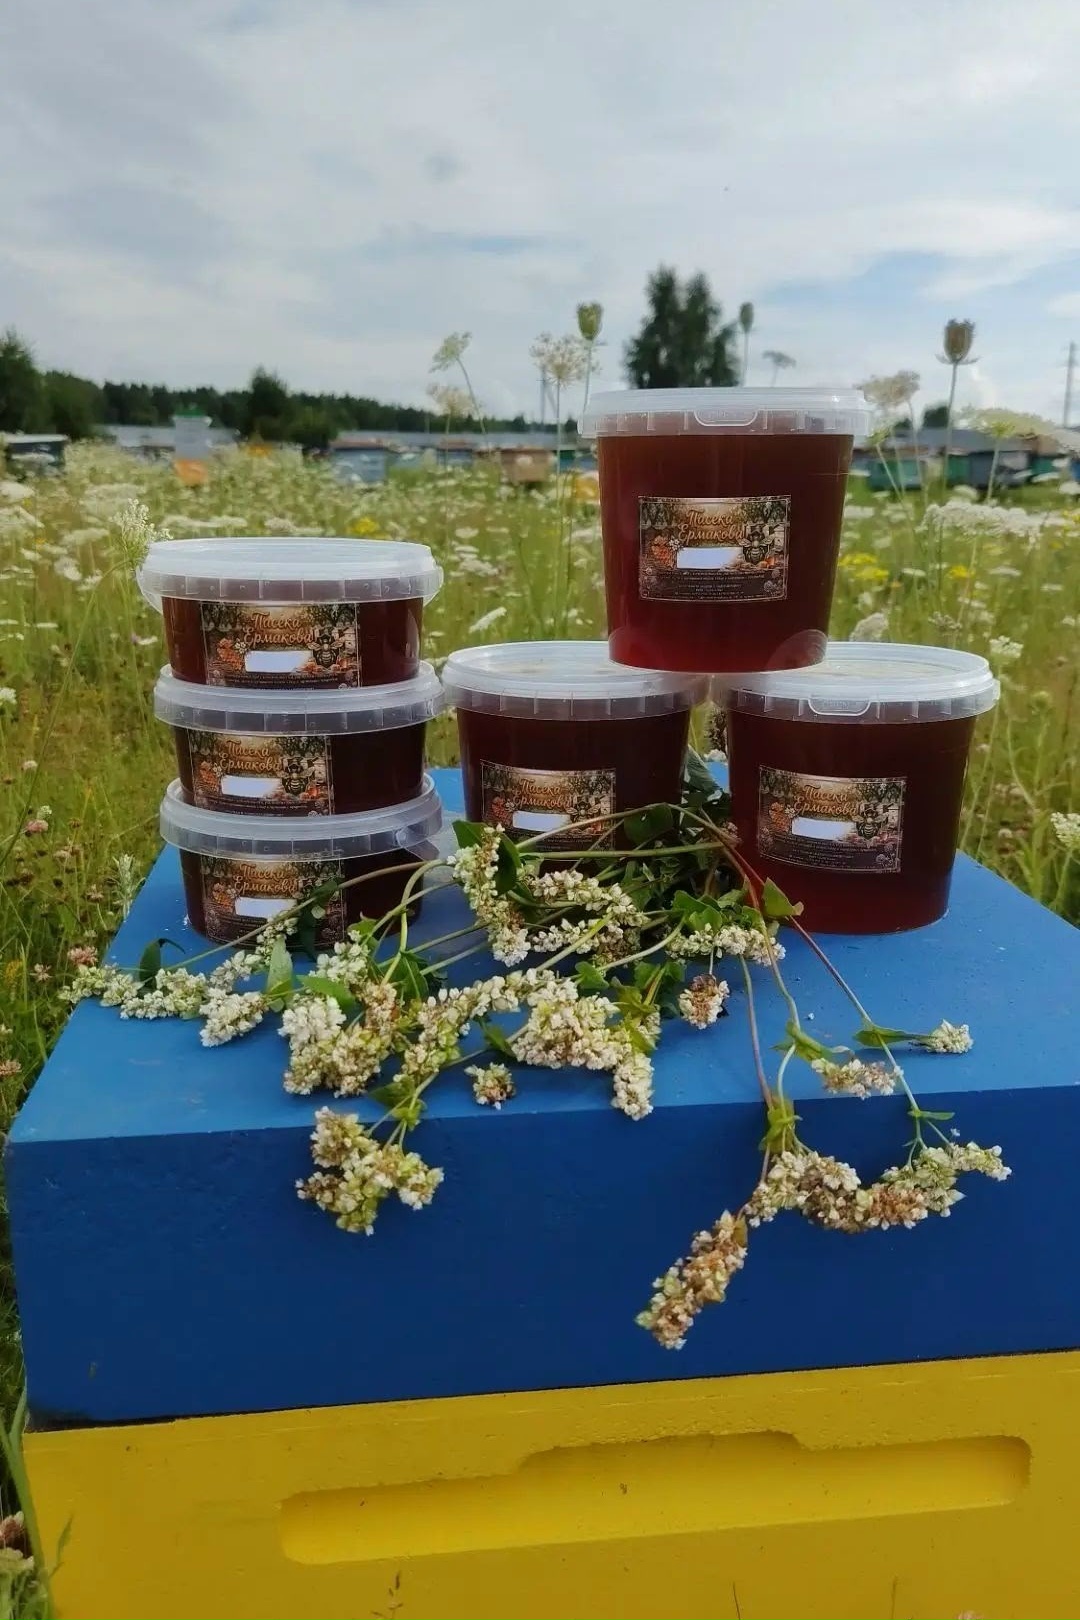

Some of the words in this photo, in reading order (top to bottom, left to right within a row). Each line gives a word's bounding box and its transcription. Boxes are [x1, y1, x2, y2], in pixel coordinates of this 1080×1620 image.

[686, 510, 734, 527] Пасека
[678, 524, 743, 545] Ермакова
[252, 612, 301, 630] Пасека
[243, 626, 314, 648] Ермакова
[219, 752, 281, 773] Ермакова
[804, 784, 848, 802] Пасека
[794, 795, 858, 817] Ермакова
